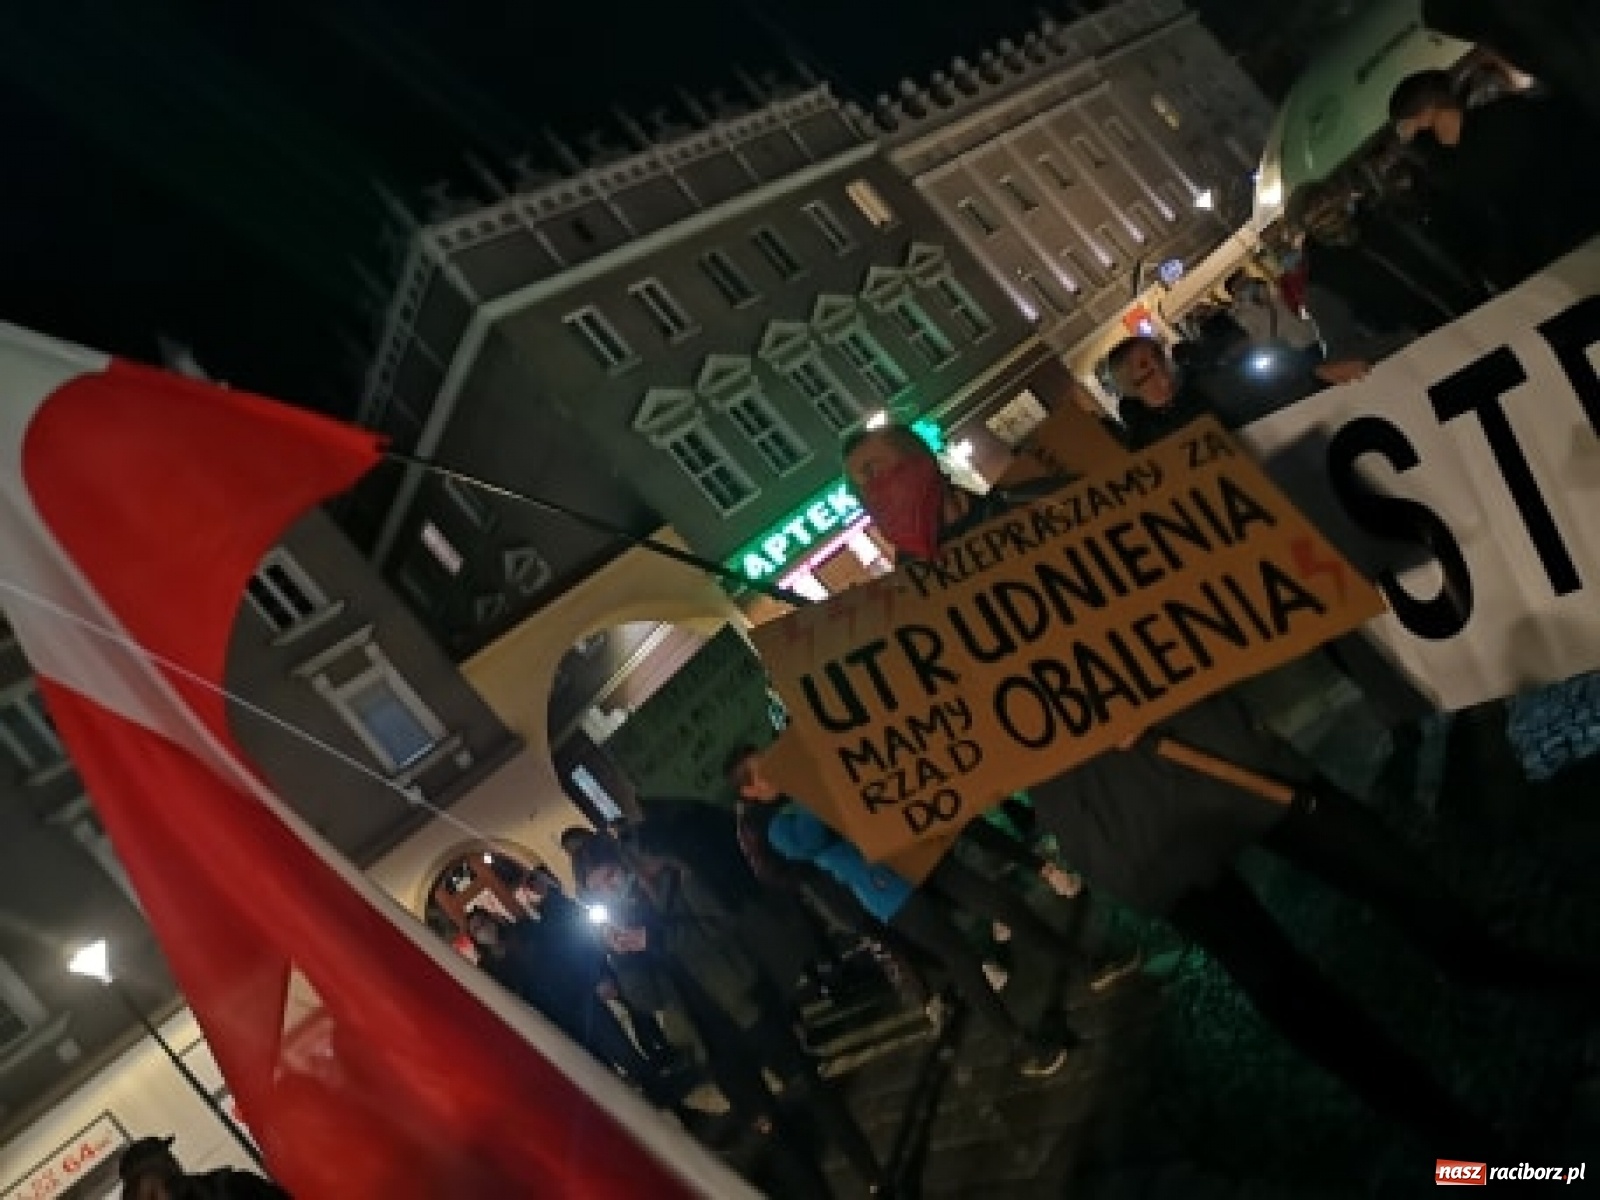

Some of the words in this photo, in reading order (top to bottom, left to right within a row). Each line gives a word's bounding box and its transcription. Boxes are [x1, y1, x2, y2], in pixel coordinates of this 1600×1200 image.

[906, 459, 1162, 597] PRZEPRASZAMY
[1179, 432, 1237, 469] ZA
[993, 559, 1326, 749] OBALENIA
[837, 697, 973, 783] MAMY
[901, 788, 961, 835] DO
